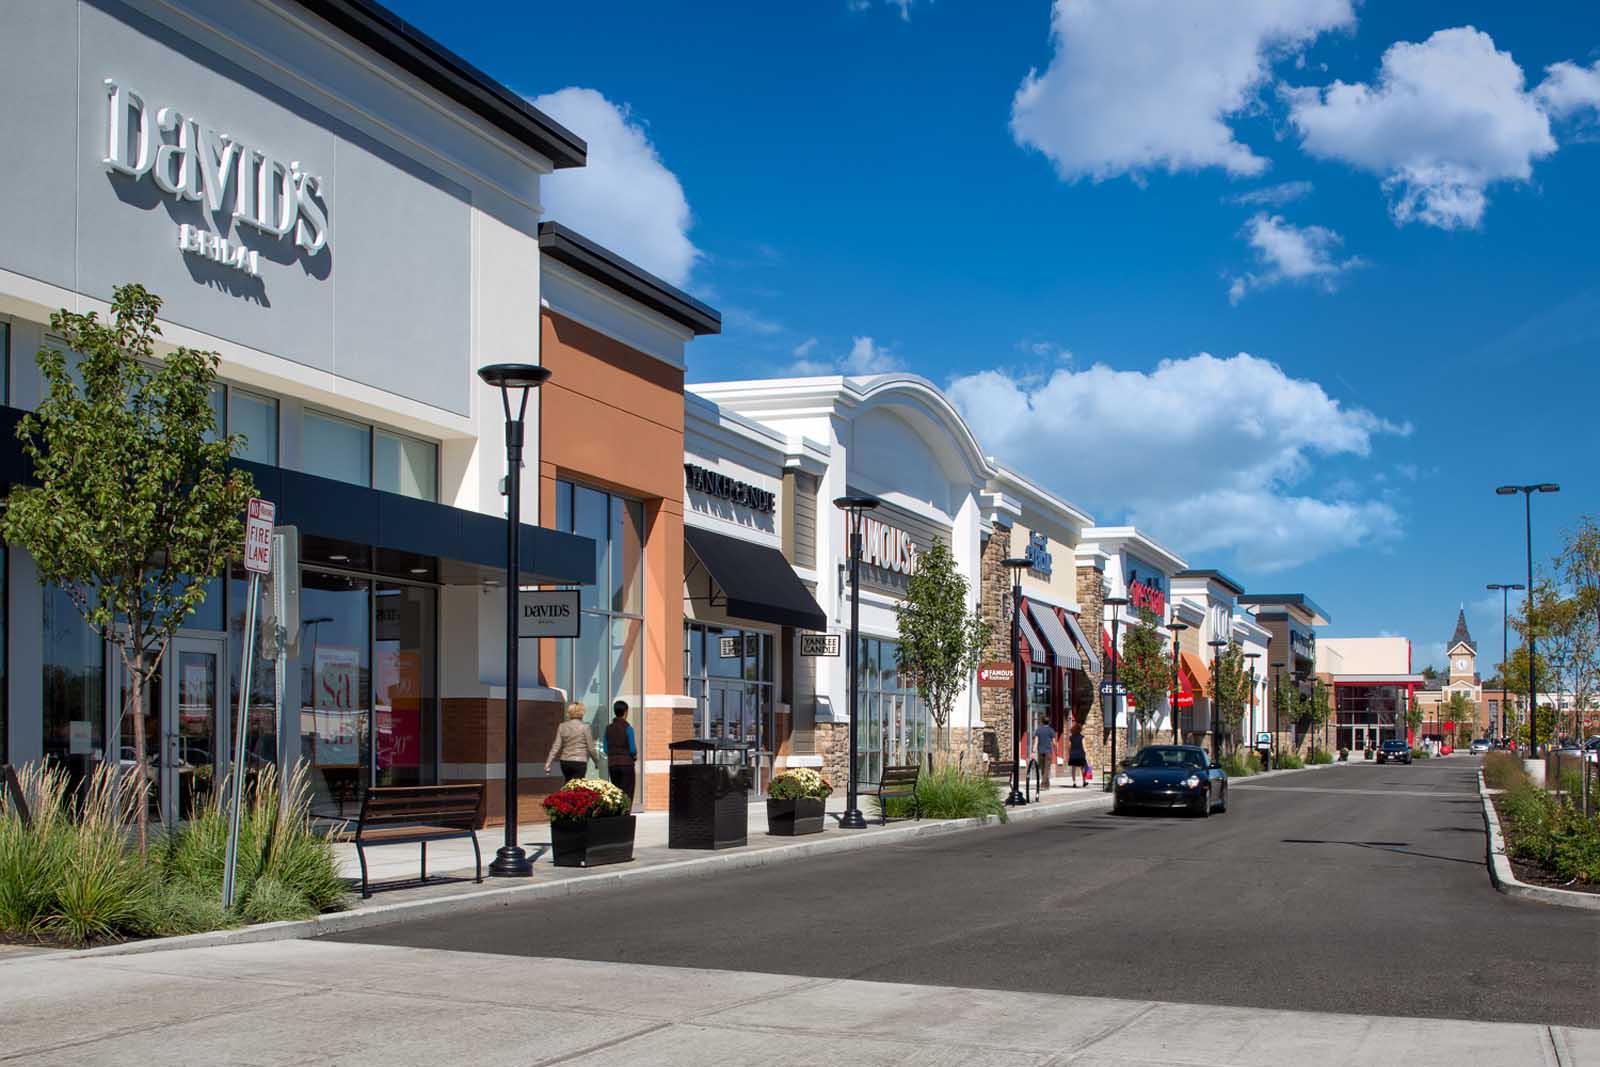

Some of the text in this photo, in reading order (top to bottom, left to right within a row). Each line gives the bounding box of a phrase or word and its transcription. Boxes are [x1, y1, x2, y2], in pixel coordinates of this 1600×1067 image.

[251, 526, 270, 545] FIRE
[249, 546, 269, 564] LANE
[804, 638, 836, 646] YANKEE
[804, 646, 836, 654] CANDLE
[990, 669, 1014, 677] FAMOUS
